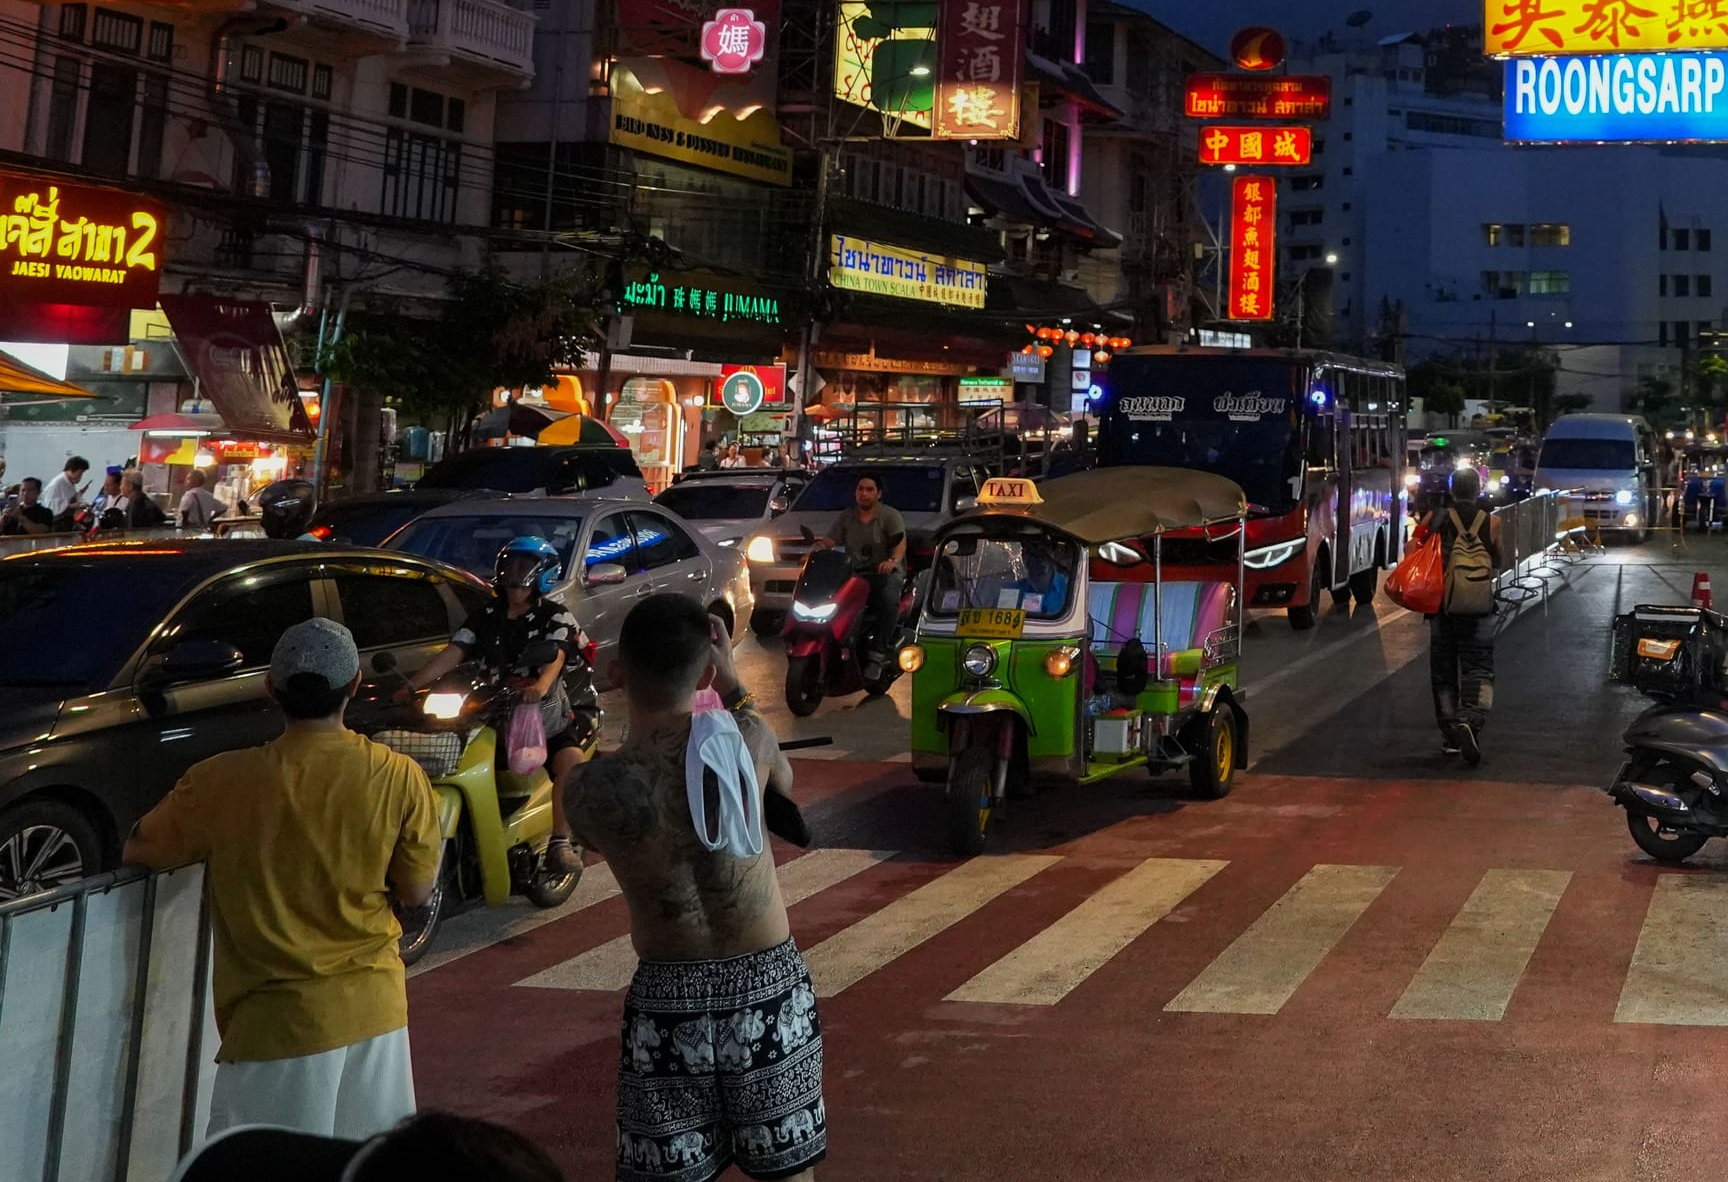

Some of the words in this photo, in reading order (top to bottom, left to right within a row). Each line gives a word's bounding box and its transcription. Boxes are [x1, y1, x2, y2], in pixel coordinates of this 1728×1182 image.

[716, 24, 750, 58] 媽
[1515, 57, 1725, 115] ROONGSARP
[1205, 129, 1301, 162] 中國城
[836, 236, 927, 283] ไชน่าทาวน์
[1239, 181, 1264, 315] 銀都魚翅酒樓
[12, 261, 51, 278] JAESI
[55, 264, 127, 284] YAOWARAT
[833, 272, 861, 289] CHINA
[864, 277, 889, 293] TOWN
[890, 282, 916, 297] SCALA
[987, 482, 1024, 498] TAXI
[989, 610, 1021, 626] 1684
